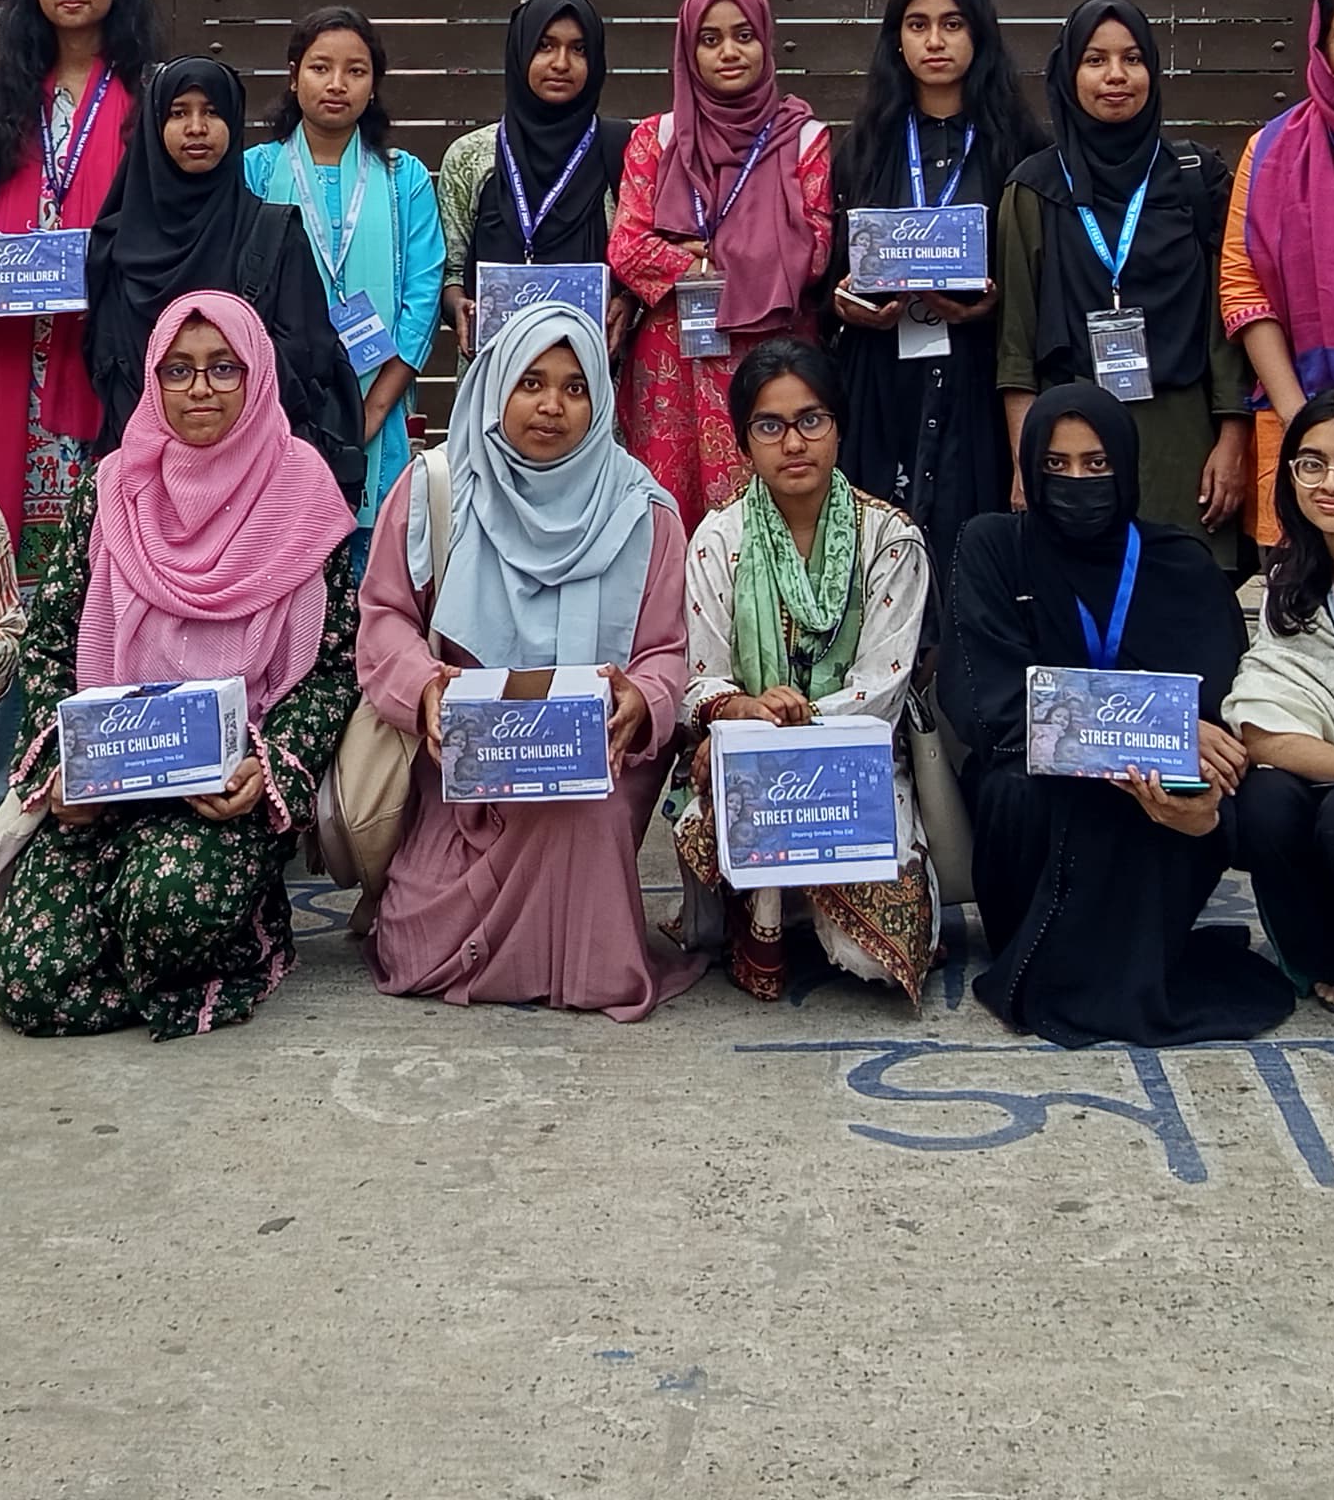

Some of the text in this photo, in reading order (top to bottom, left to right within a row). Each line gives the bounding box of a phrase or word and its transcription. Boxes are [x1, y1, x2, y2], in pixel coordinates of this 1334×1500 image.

[892, 215, 940, 244] Eid
[879, 247, 960, 259] STREET CHILDREN
[17, 270, 59, 283] CHILDREN
[100, 697, 152, 738] Eid
[1097, 692, 1156, 726] Eid
[492, 706, 547, 743] Eid
[86, 733, 180, 759] STREET CHILDREN
[477, 744, 573, 761] STREET CHILDREN
[1079, 730, 1180, 751] STREET CHILDREN
[768, 765, 823, 806] Eid
[753, 806, 850, 826] STREET CHILDREN
